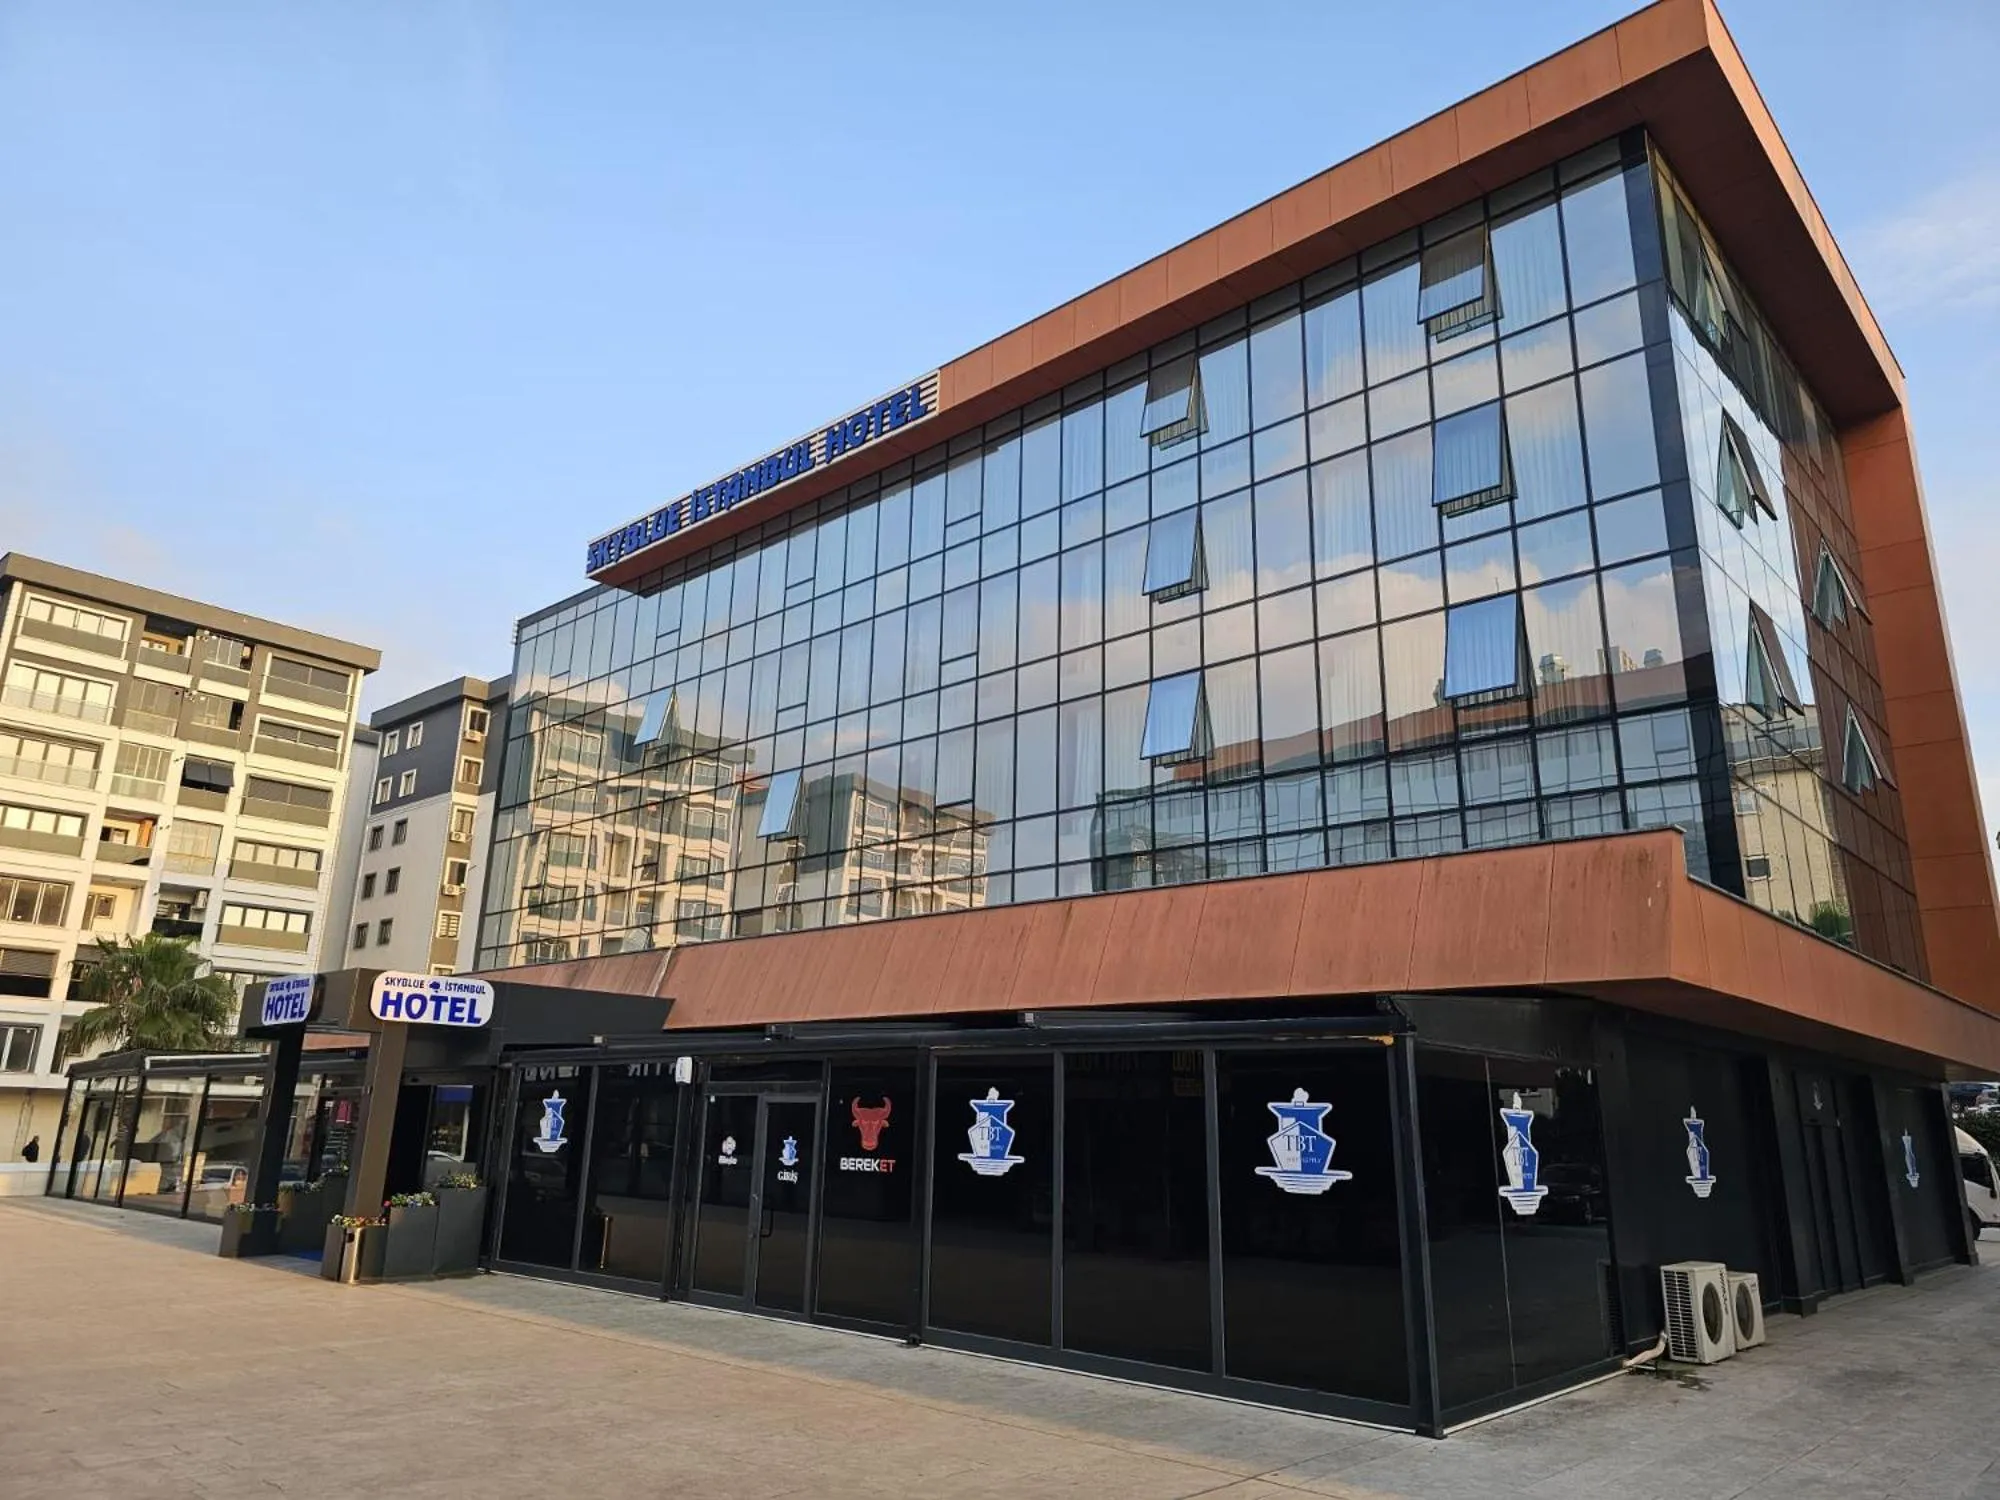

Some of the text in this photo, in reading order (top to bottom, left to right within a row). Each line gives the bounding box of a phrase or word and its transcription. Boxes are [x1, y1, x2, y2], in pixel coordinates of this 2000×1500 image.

[586, 384, 928, 574] SKYBLUE İSTANBUL HOTEL
[384, 976, 425, 990] SKYBLUE
[264, 991, 306, 1022] HOTEL
[379, 992, 482, 1023] HOTEL
[1282, 1134, 1317, 1153] TBT
[840, 1157, 896, 1173] BEREKET
